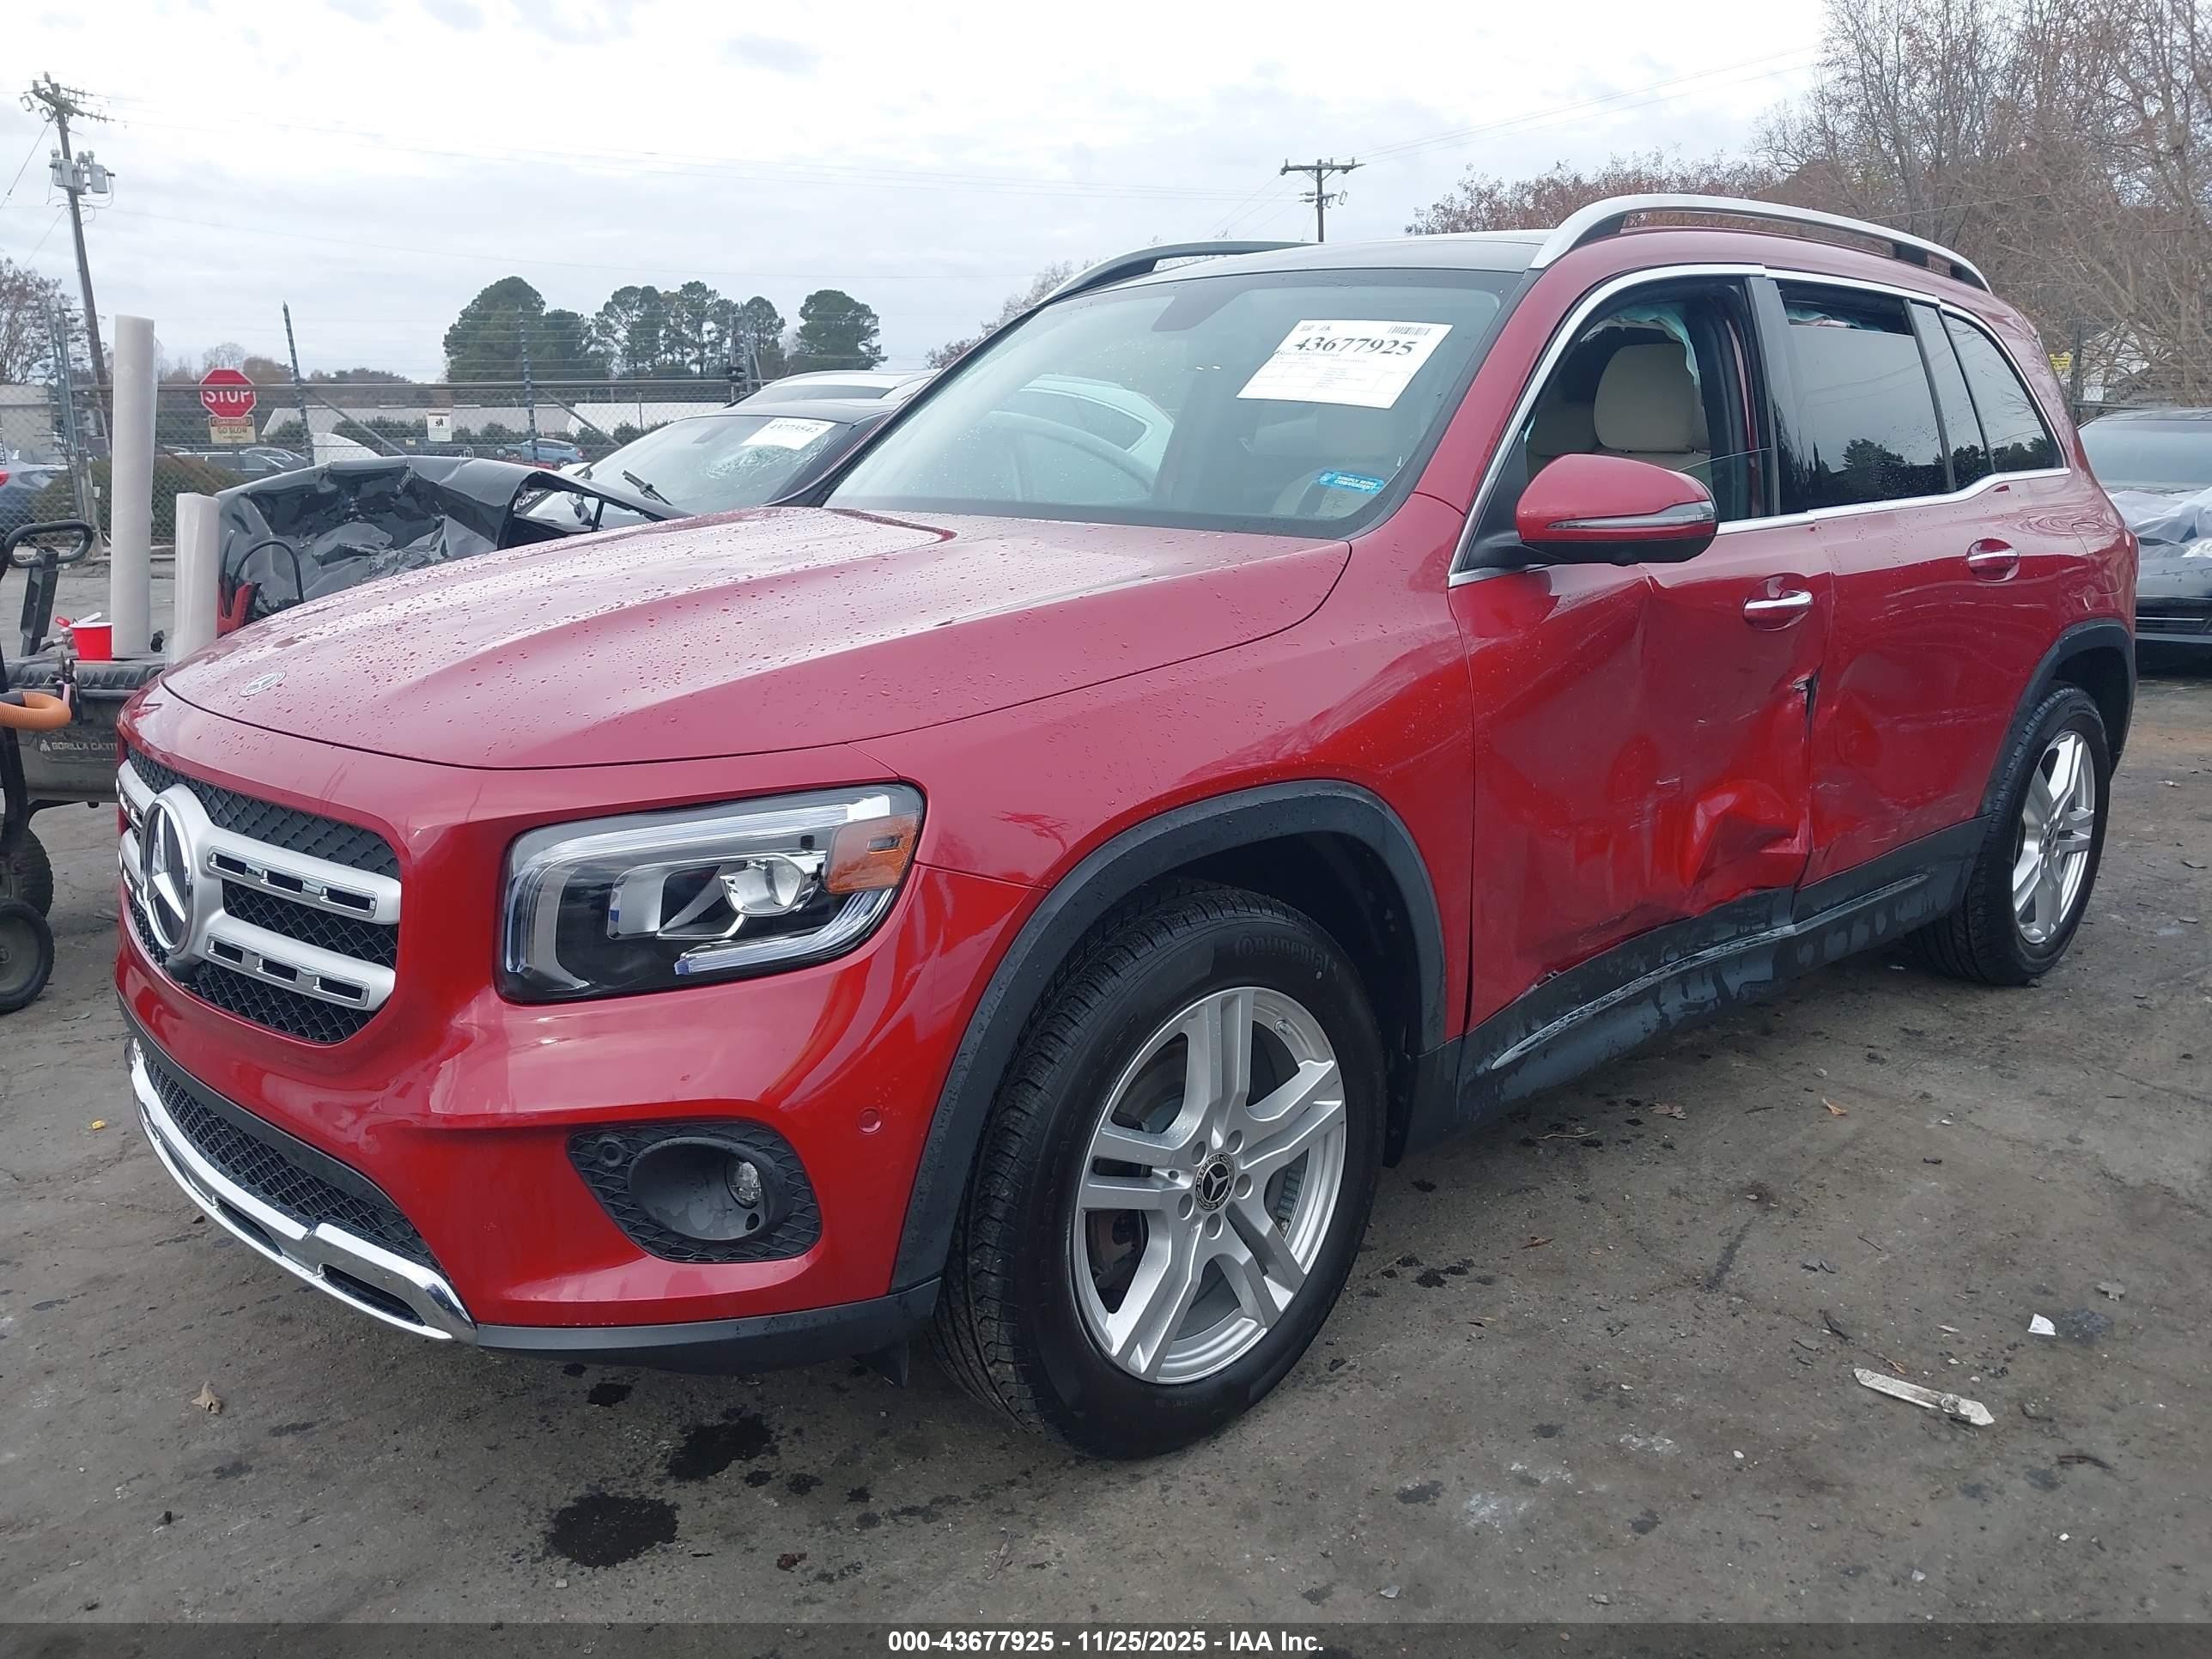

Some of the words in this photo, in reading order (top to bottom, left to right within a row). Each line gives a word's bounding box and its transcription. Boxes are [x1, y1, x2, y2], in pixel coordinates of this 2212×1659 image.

[1293, 336, 1418, 356] 43677925
[205, 388, 251, 403] STOP
[52, 742, 89, 750] GORILLA
